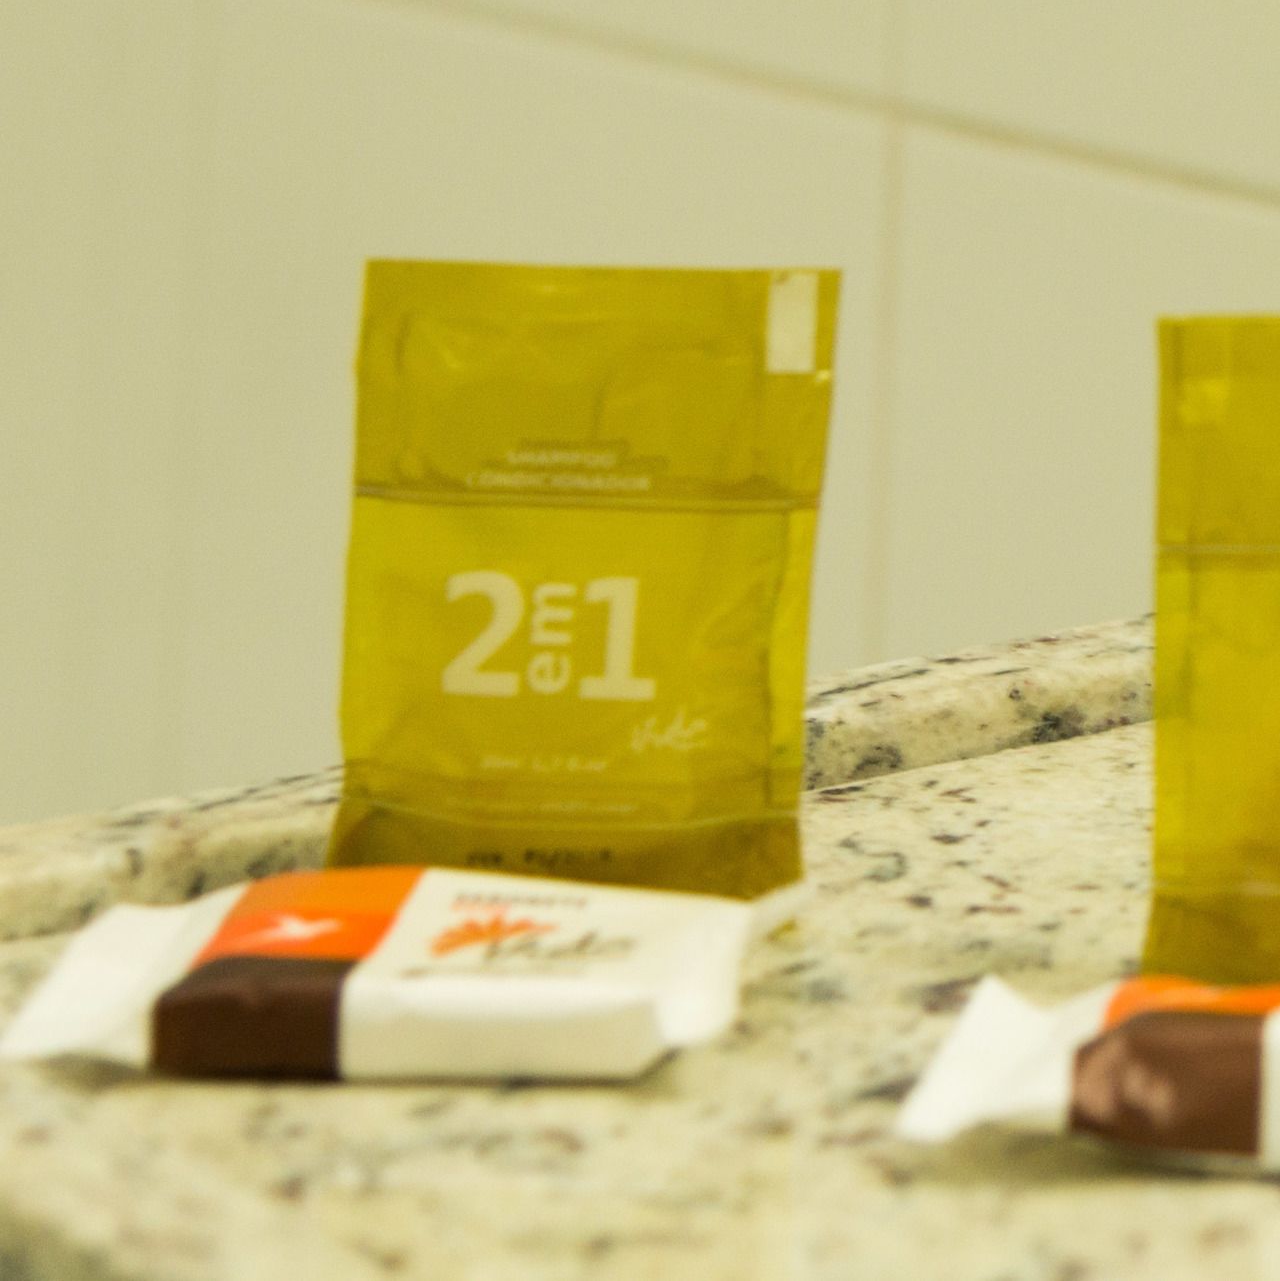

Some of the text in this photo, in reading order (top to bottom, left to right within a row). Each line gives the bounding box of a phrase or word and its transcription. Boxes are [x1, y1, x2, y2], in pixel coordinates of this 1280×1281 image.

[442, 570, 656, 701] 2 em 1
